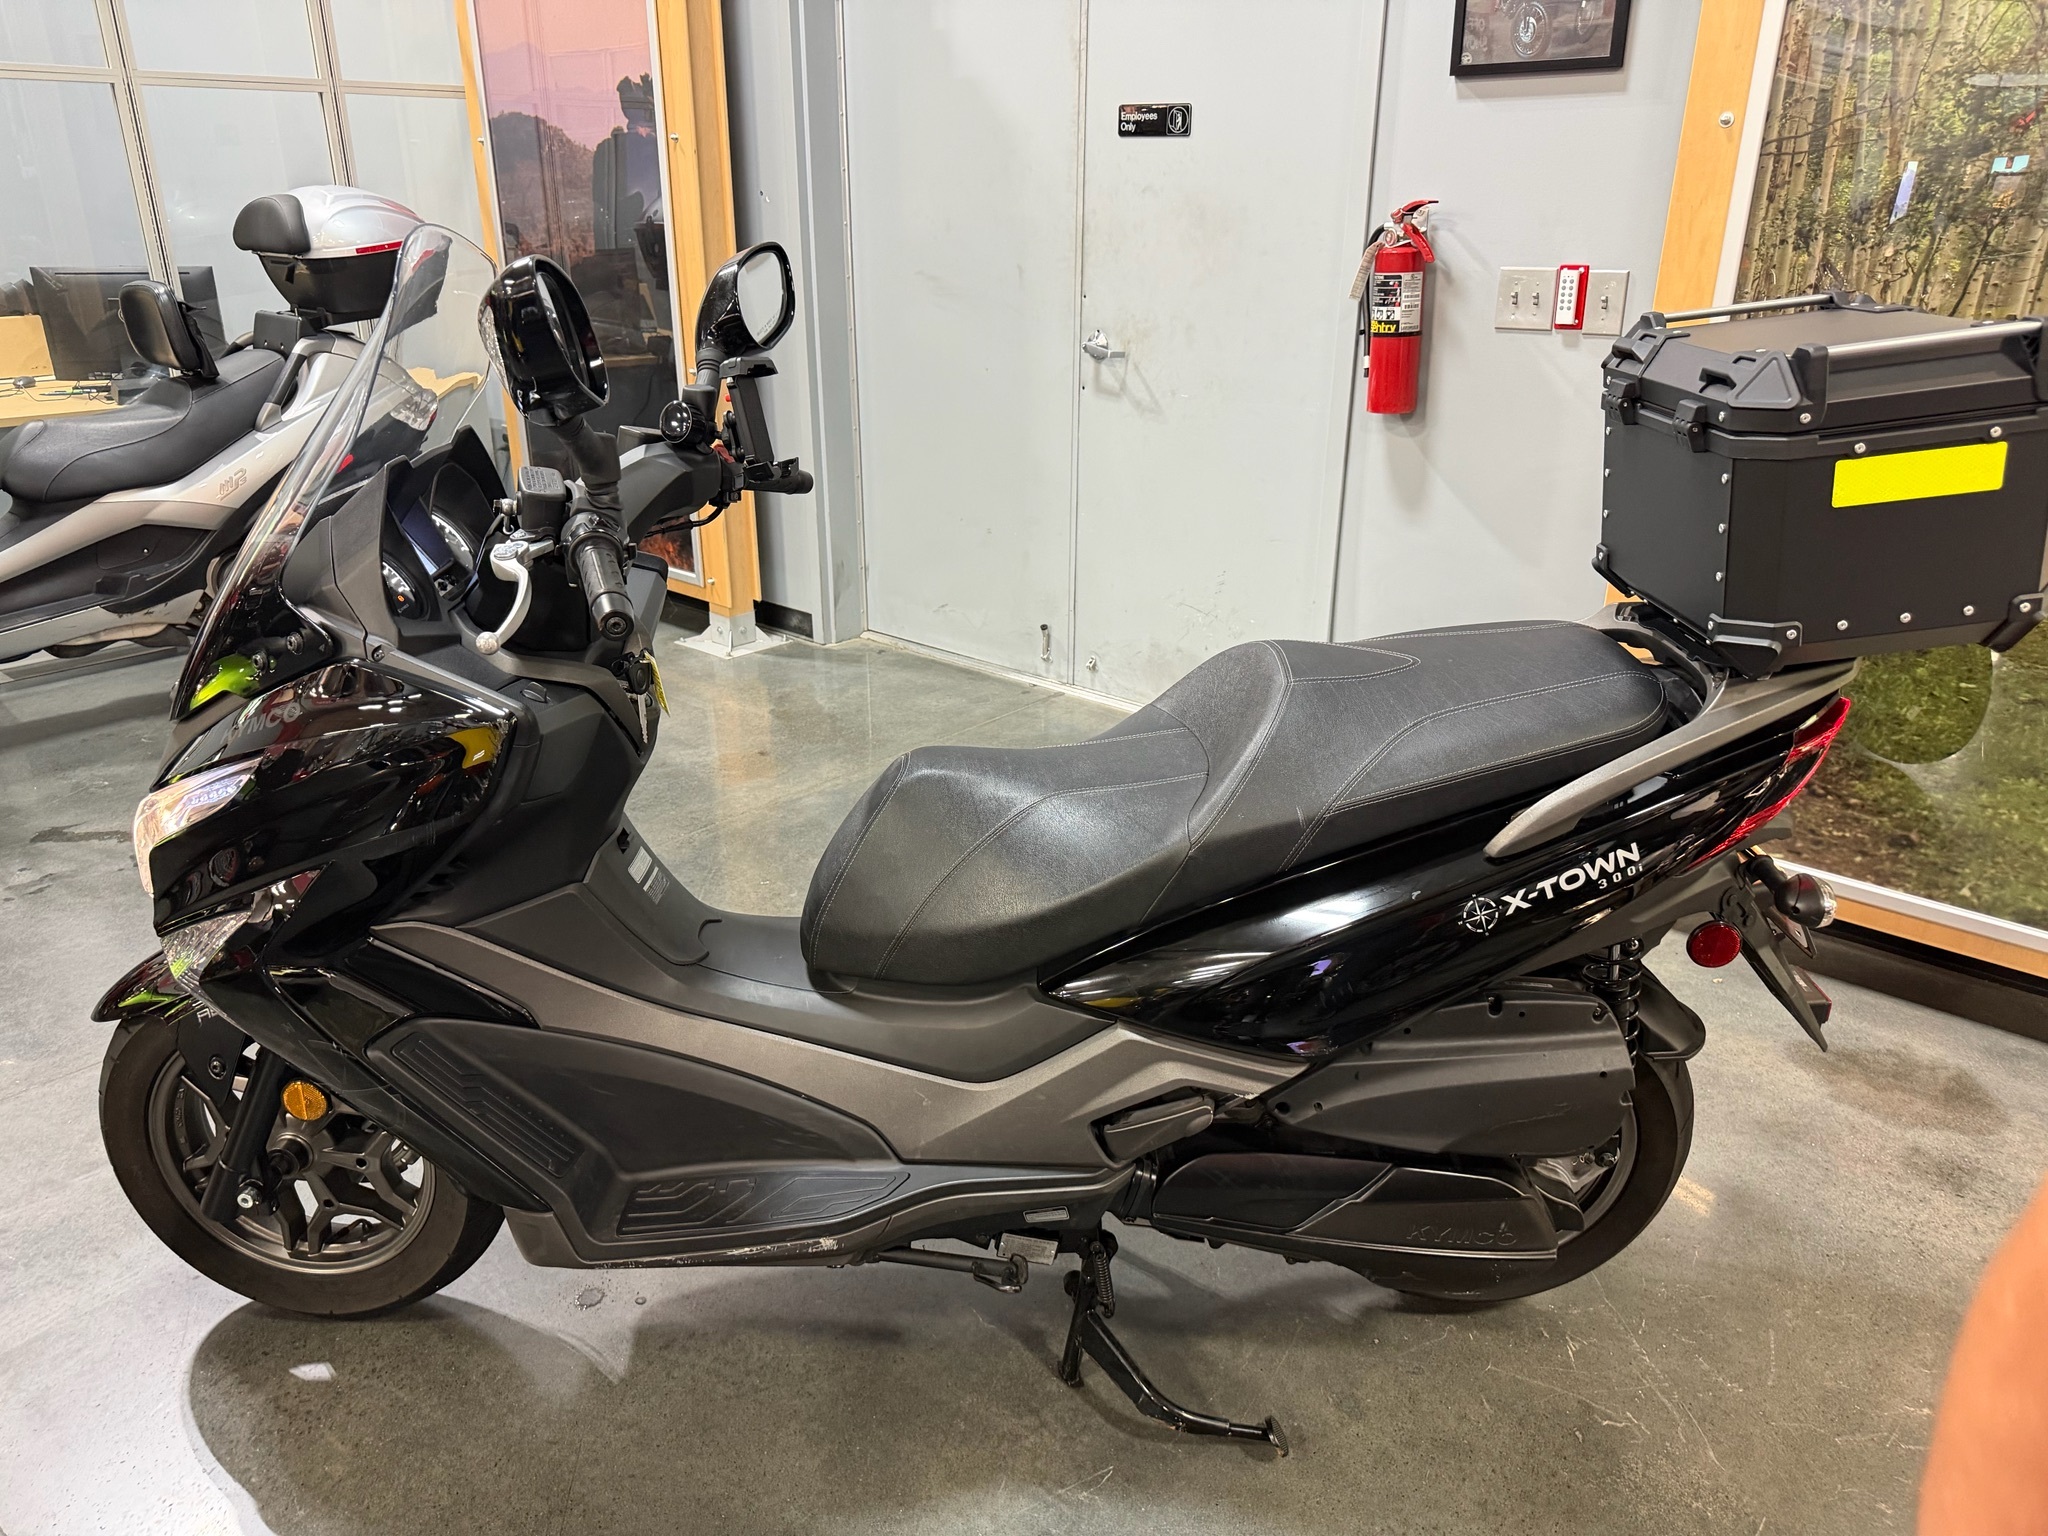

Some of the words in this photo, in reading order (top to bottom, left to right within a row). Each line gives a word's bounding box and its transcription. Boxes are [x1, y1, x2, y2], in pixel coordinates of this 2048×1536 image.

[1120, 122, 1136, 133] Only
[1121, 111, 1158, 122] Employees
[221, 700, 301, 745] KYMCO
[1501, 842, 1641, 917] X-TOWN
[1598, 863, 1644, 890] 300i
